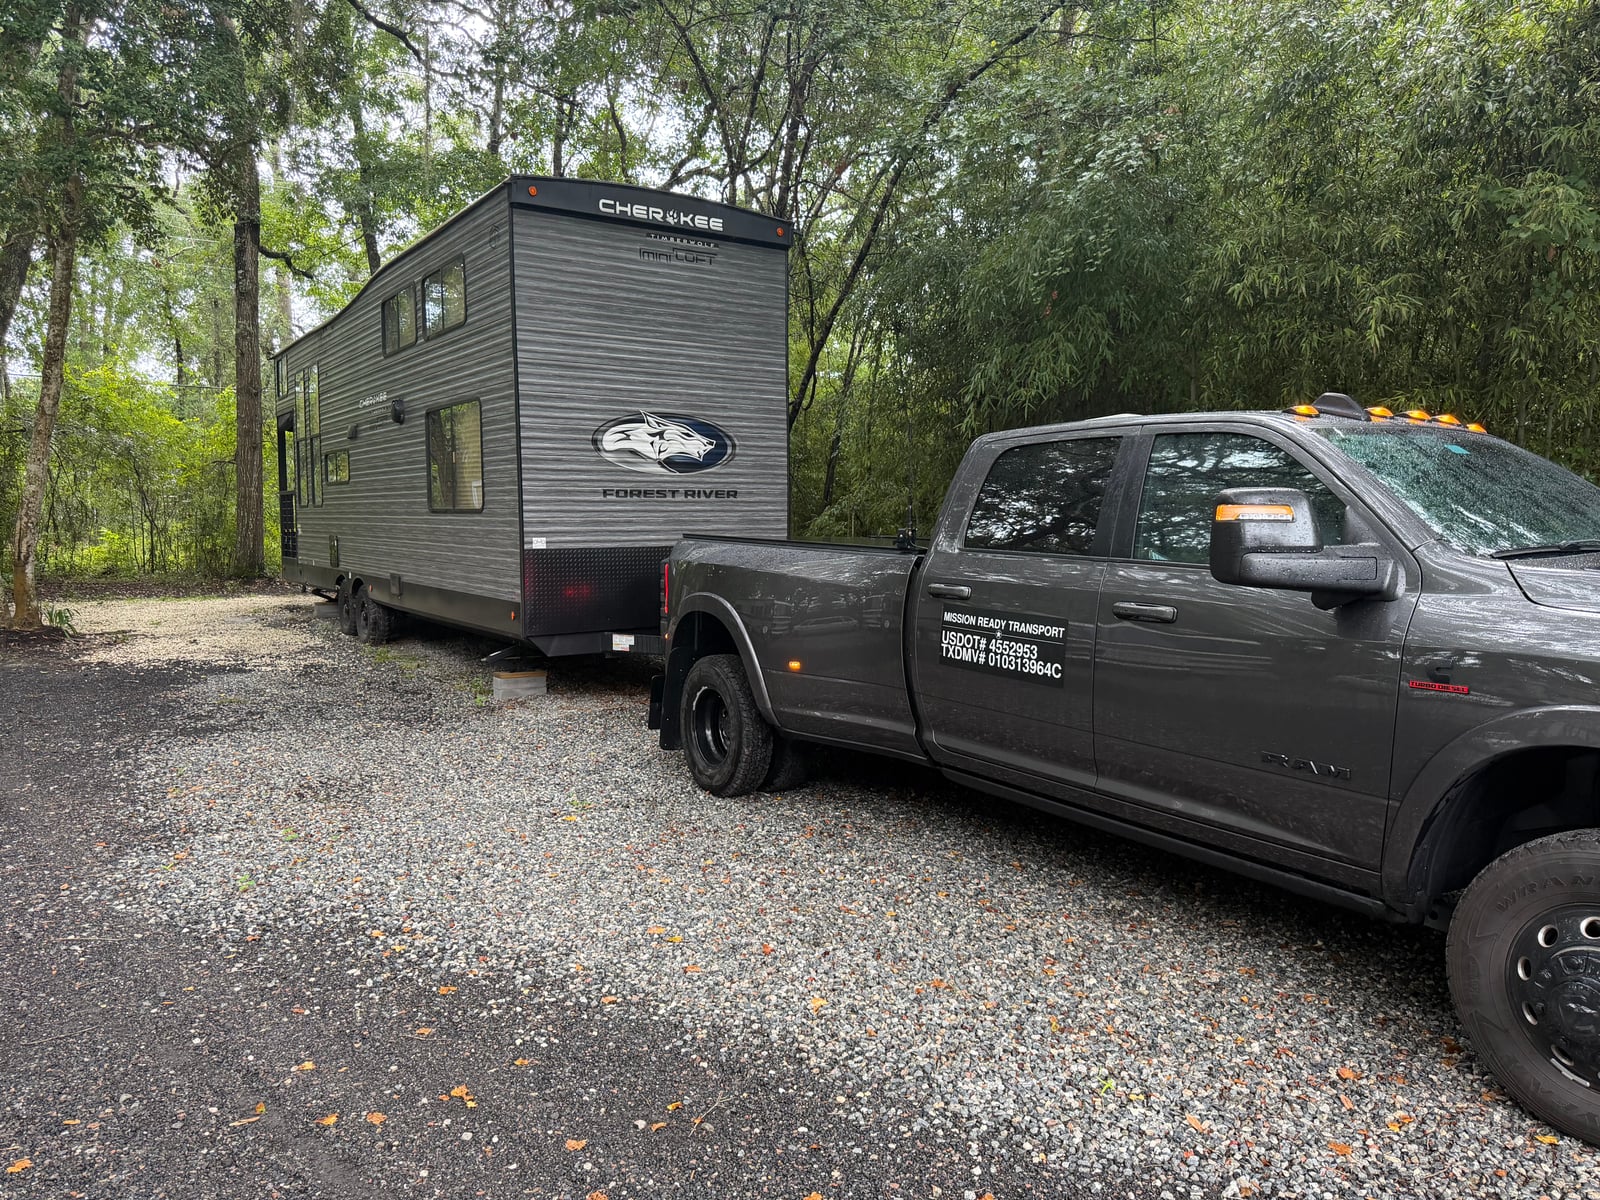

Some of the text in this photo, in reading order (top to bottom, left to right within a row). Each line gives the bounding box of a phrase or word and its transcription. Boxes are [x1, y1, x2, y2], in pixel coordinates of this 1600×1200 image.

[649, 233, 716, 248] TIMBERWOLF
[602, 488, 738, 499] FOREST RIVER
[943, 611, 1066, 639] MISSION READY TRANSPORT
[941, 630, 1038, 660] USDOT# 4552953
[941, 643, 1062, 679] TXDMV# 010313964C
[1411, 681, 1467, 692] TURBO DIESEL
[1260, 750, 1352, 780] RAM
